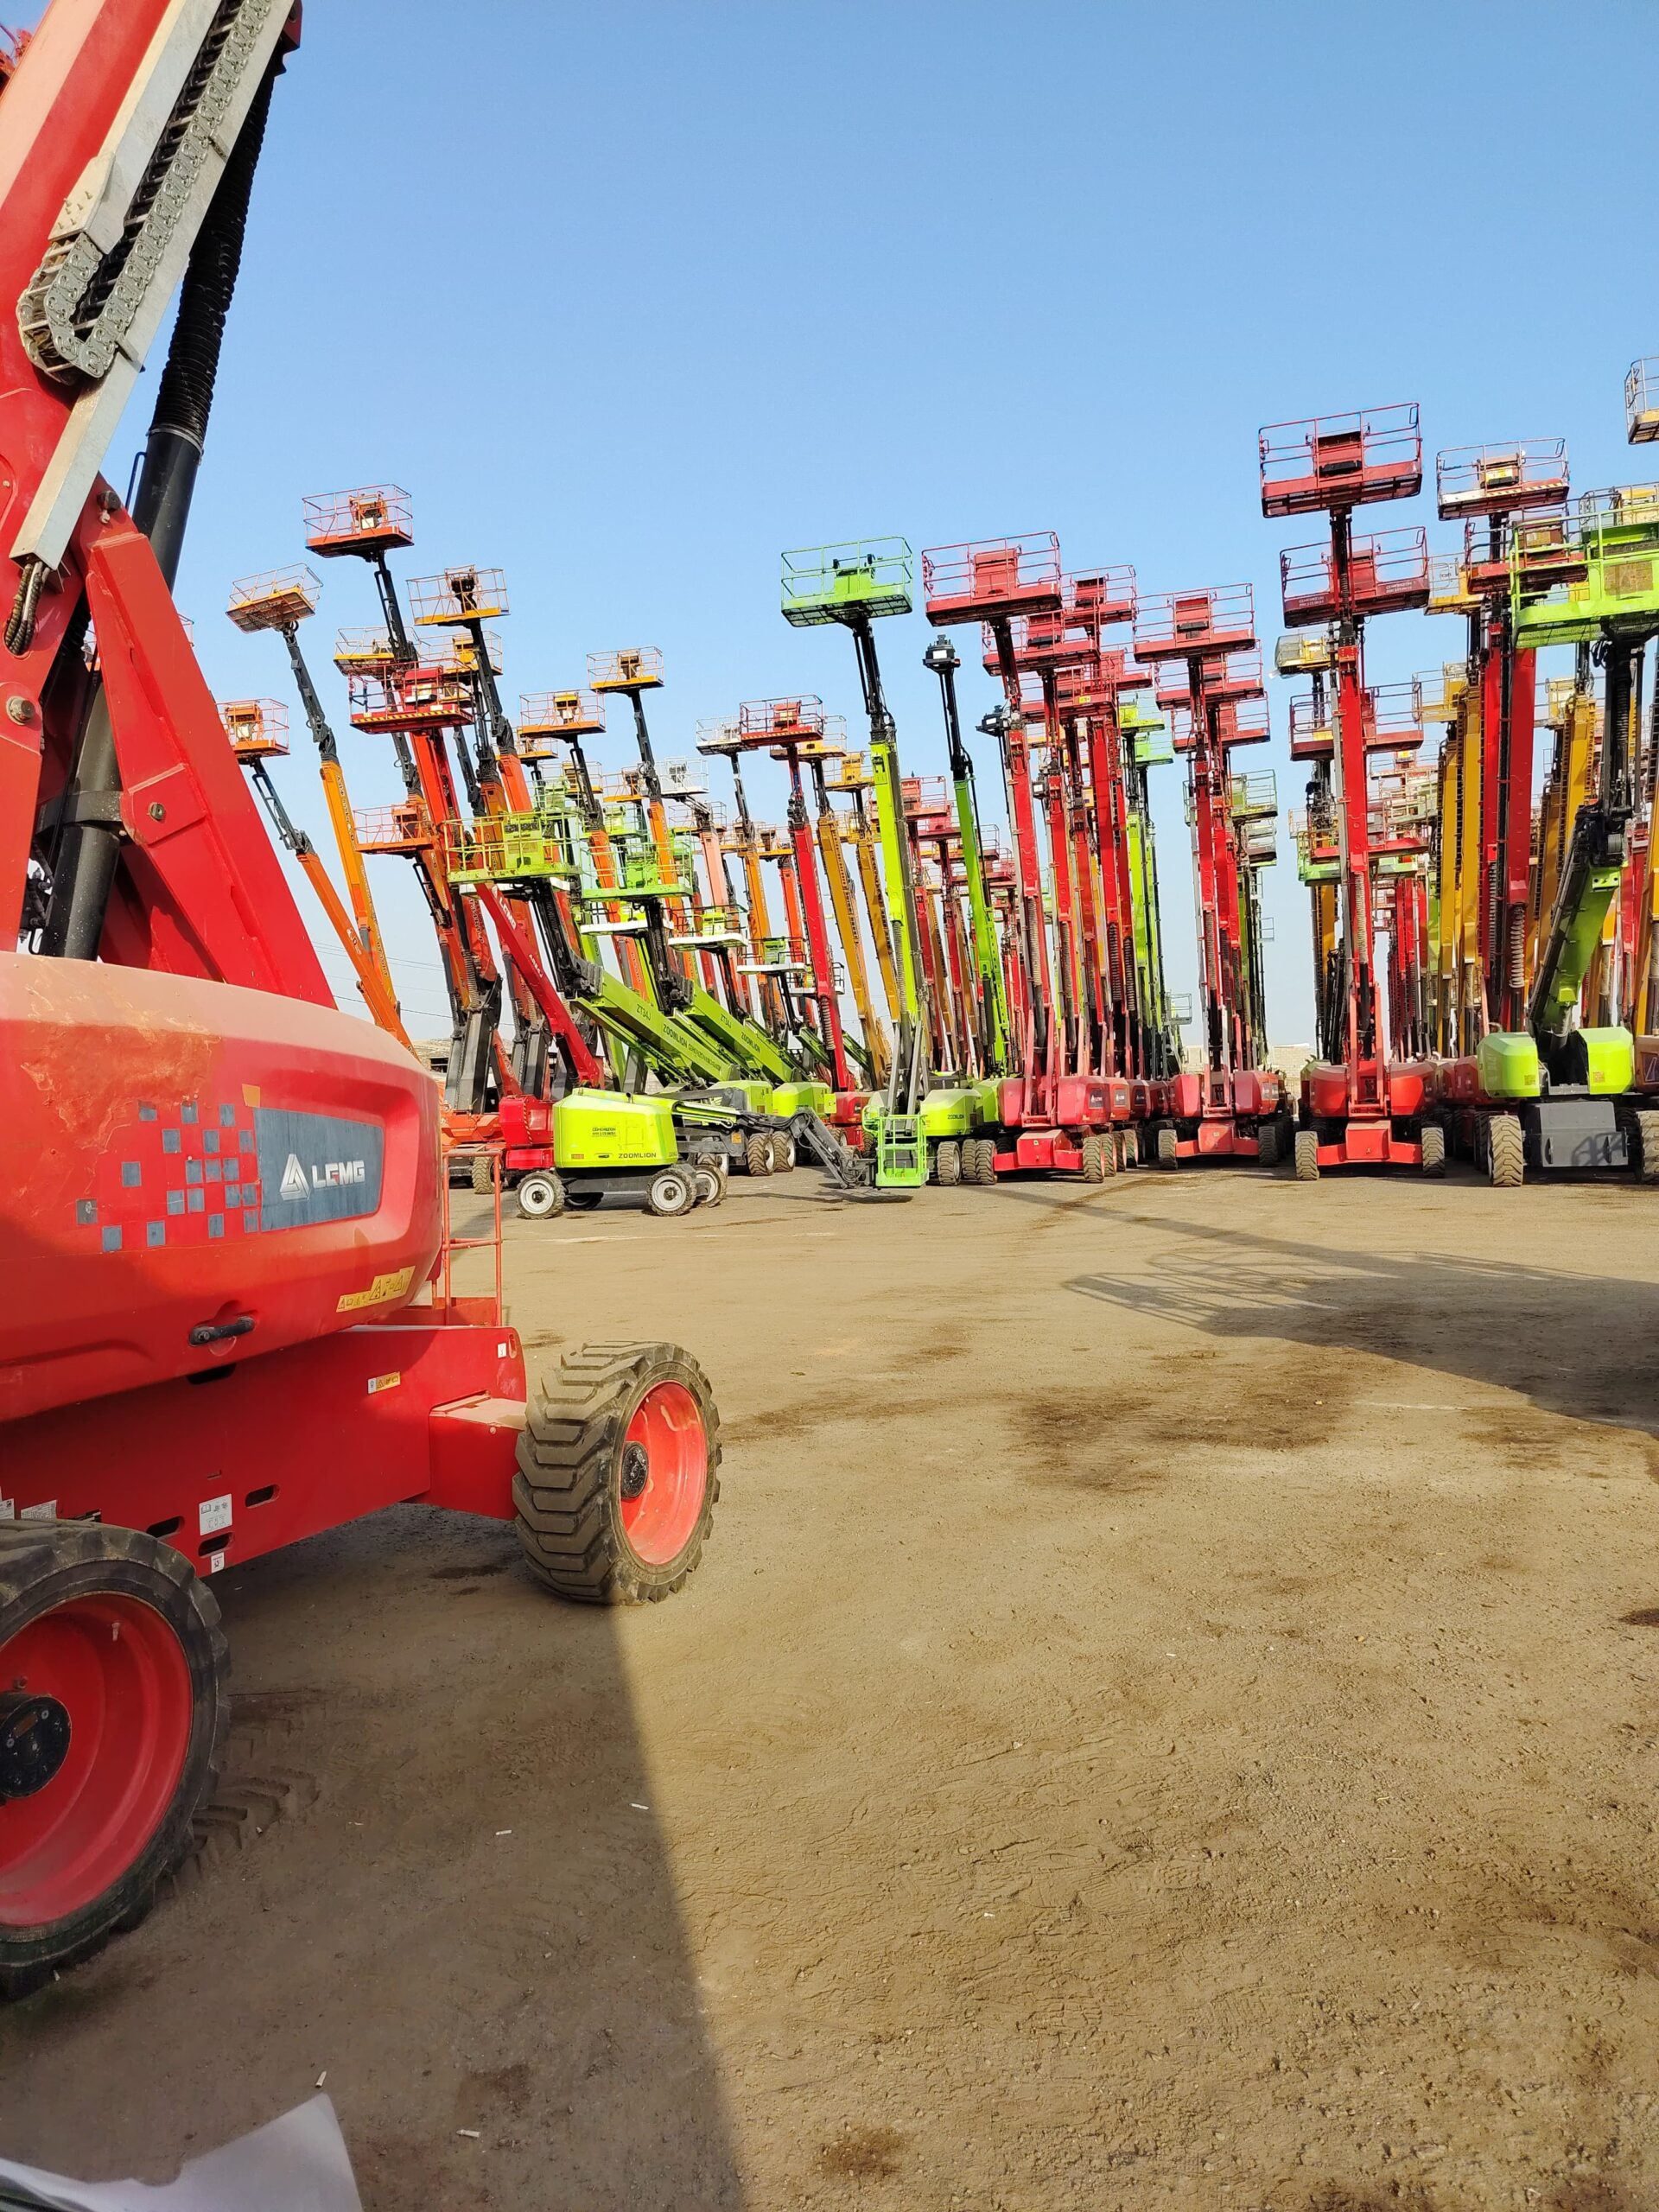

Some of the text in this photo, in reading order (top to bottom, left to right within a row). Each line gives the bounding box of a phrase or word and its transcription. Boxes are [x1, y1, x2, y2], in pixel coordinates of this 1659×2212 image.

[499, 897, 517, 930] LGMG
[663, 1023, 688, 1049] ZOOMLION
[312, 1160, 365, 1189] LGMG
